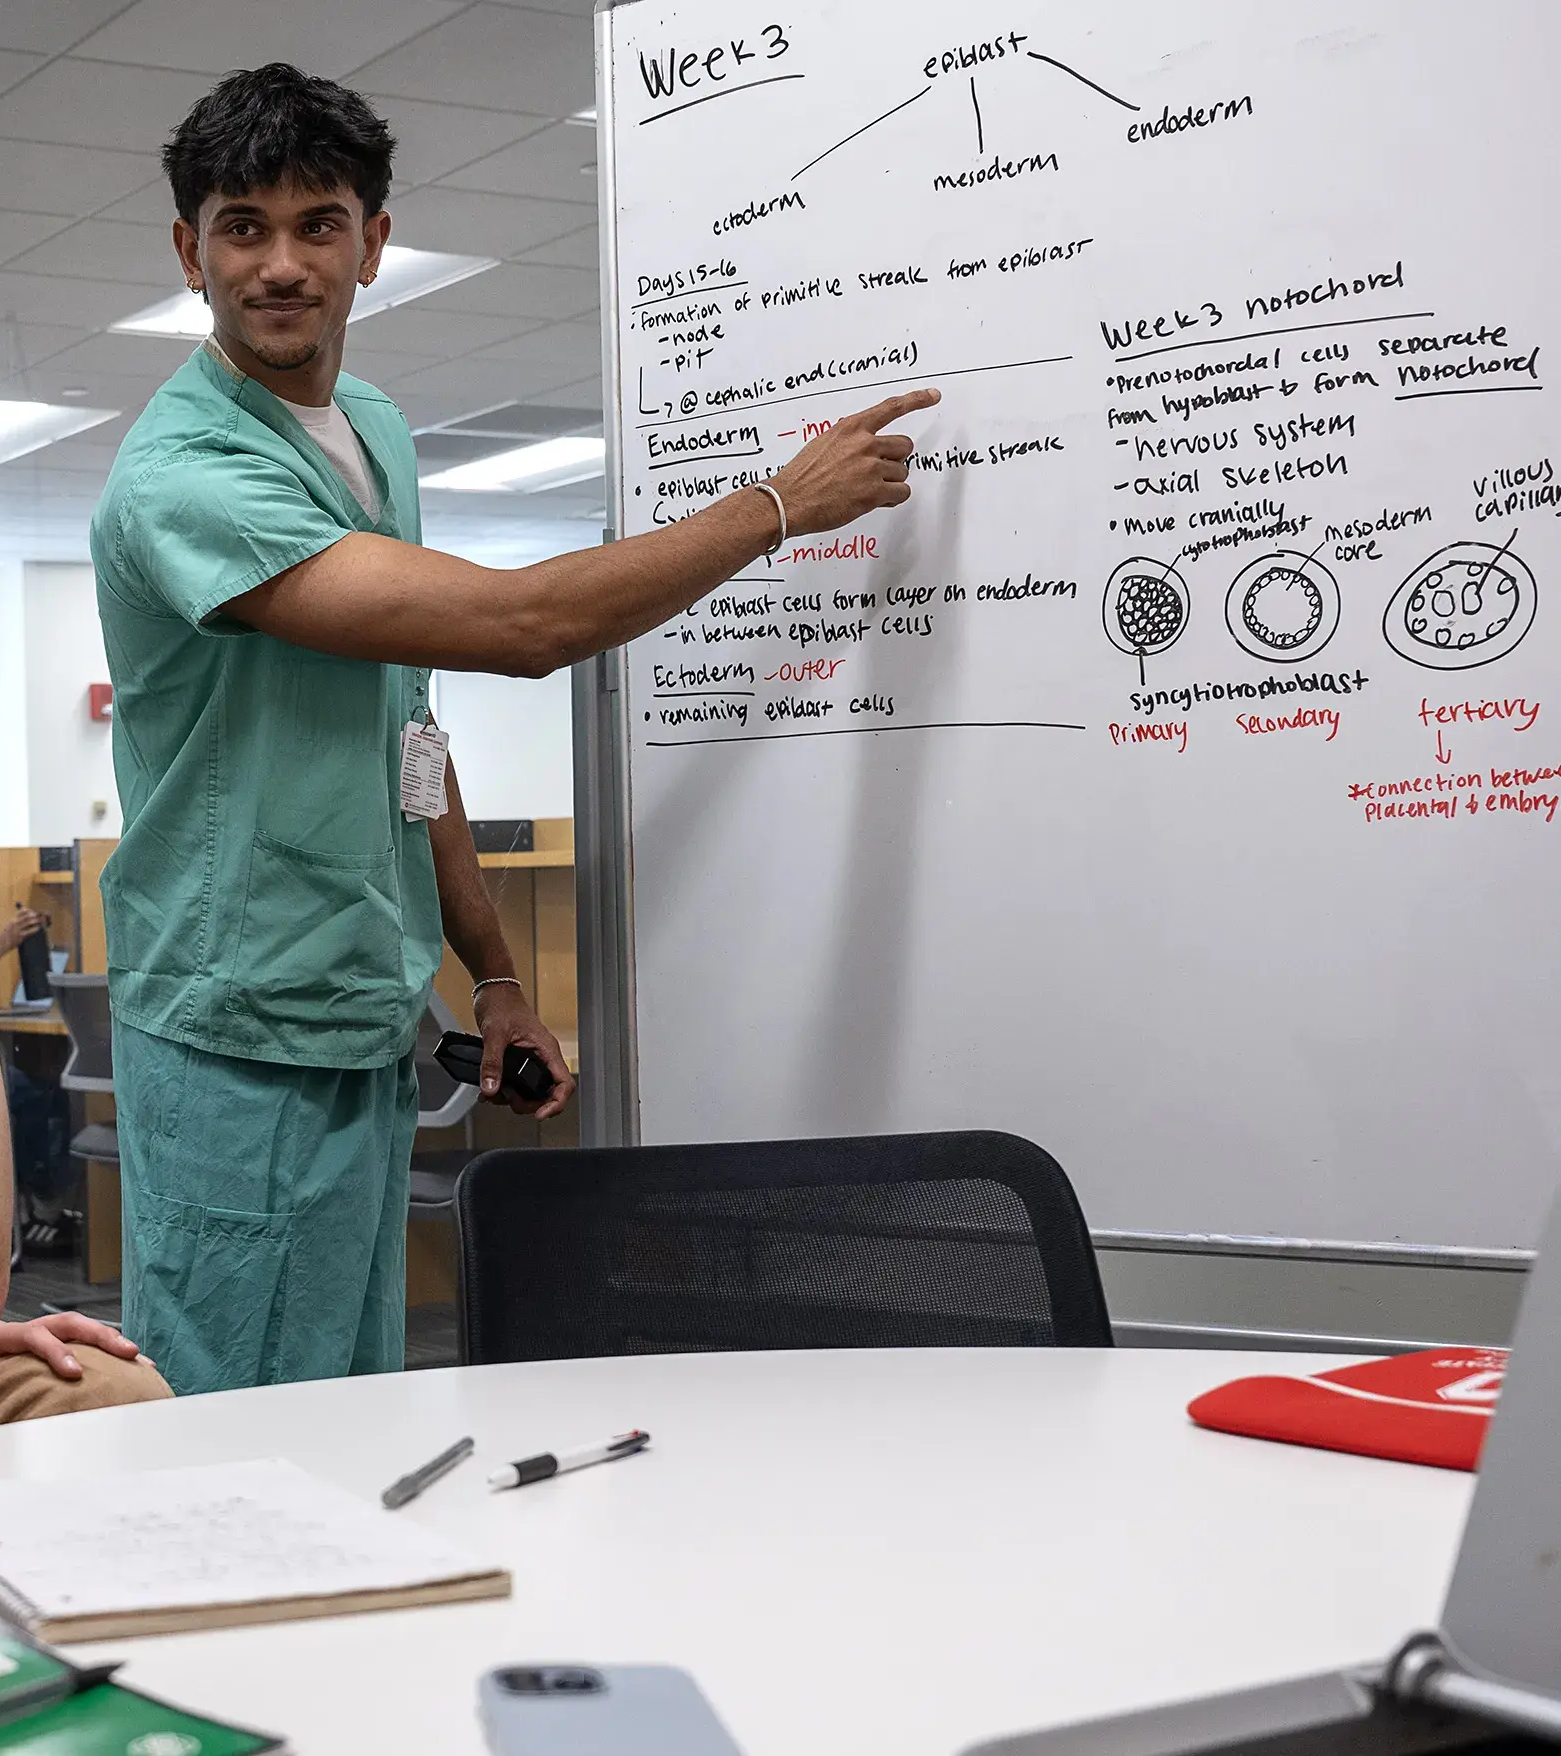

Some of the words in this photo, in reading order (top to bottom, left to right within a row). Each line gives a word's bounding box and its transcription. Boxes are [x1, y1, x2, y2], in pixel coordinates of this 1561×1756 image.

[924, 32, 1028, 78] epiblast
[1127, 95, 1253, 143] endoderm
[933, 152, 1059, 191] mesoderm
[712, 190, 806, 236] ectoderm
[638, 270, 685, 296] Days
[734, 292, 751, 311] of
[761, 278, 843, 309] primitive
[858, 265, 928, 289] streak
[947, 259, 987, 280] from
[997, 238, 1094, 273] epiblast
[1100, 310, 1199, 350] Week
[1200, 302, 1223, 327] 3
[1300, 343, 1349, 363] cells
[1378, 325, 1508, 357] separate
[680, 390, 698, 414] @
[705, 378, 777, 407] cephalic
[784, 363, 823, 389] end
[1162, 382, 1275, 421] hypoblast
[1314, 370, 1379, 394] form
[647, 425, 760, 458] Endoderm
[1253, 412, 1355, 451] system
[658, 475, 728, 499] epiblast
[904, 446, 985, 472] rimitive
[988, 436, 1064, 465] streak
[1222, 452, 1348, 489] skeleton
[1189, 498, 1285, 529] cranially
[1325, 506, 1432, 542] mesoderm
[1335, 539, 1384, 563] core
[710, 594, 777, 618] epiblast
[782, 591, 822, 612] cells
[833, 588, 876, 610] form
[943, 583, 967, 602] on
[977, 573, 1077, 601] endoderm
[702, 620, 782, 644] between
[788, 618, 872, 648] epiblast
[881, 614, 933, 636] cells
[653, 662, 755, 688] Ectoderm
[660, 699, 748, 727] remaining
[764, 696, 834, 721] epiblast
[849, 692, 895, 716] cells
[1417, 697, 1540, 732] tertiary
